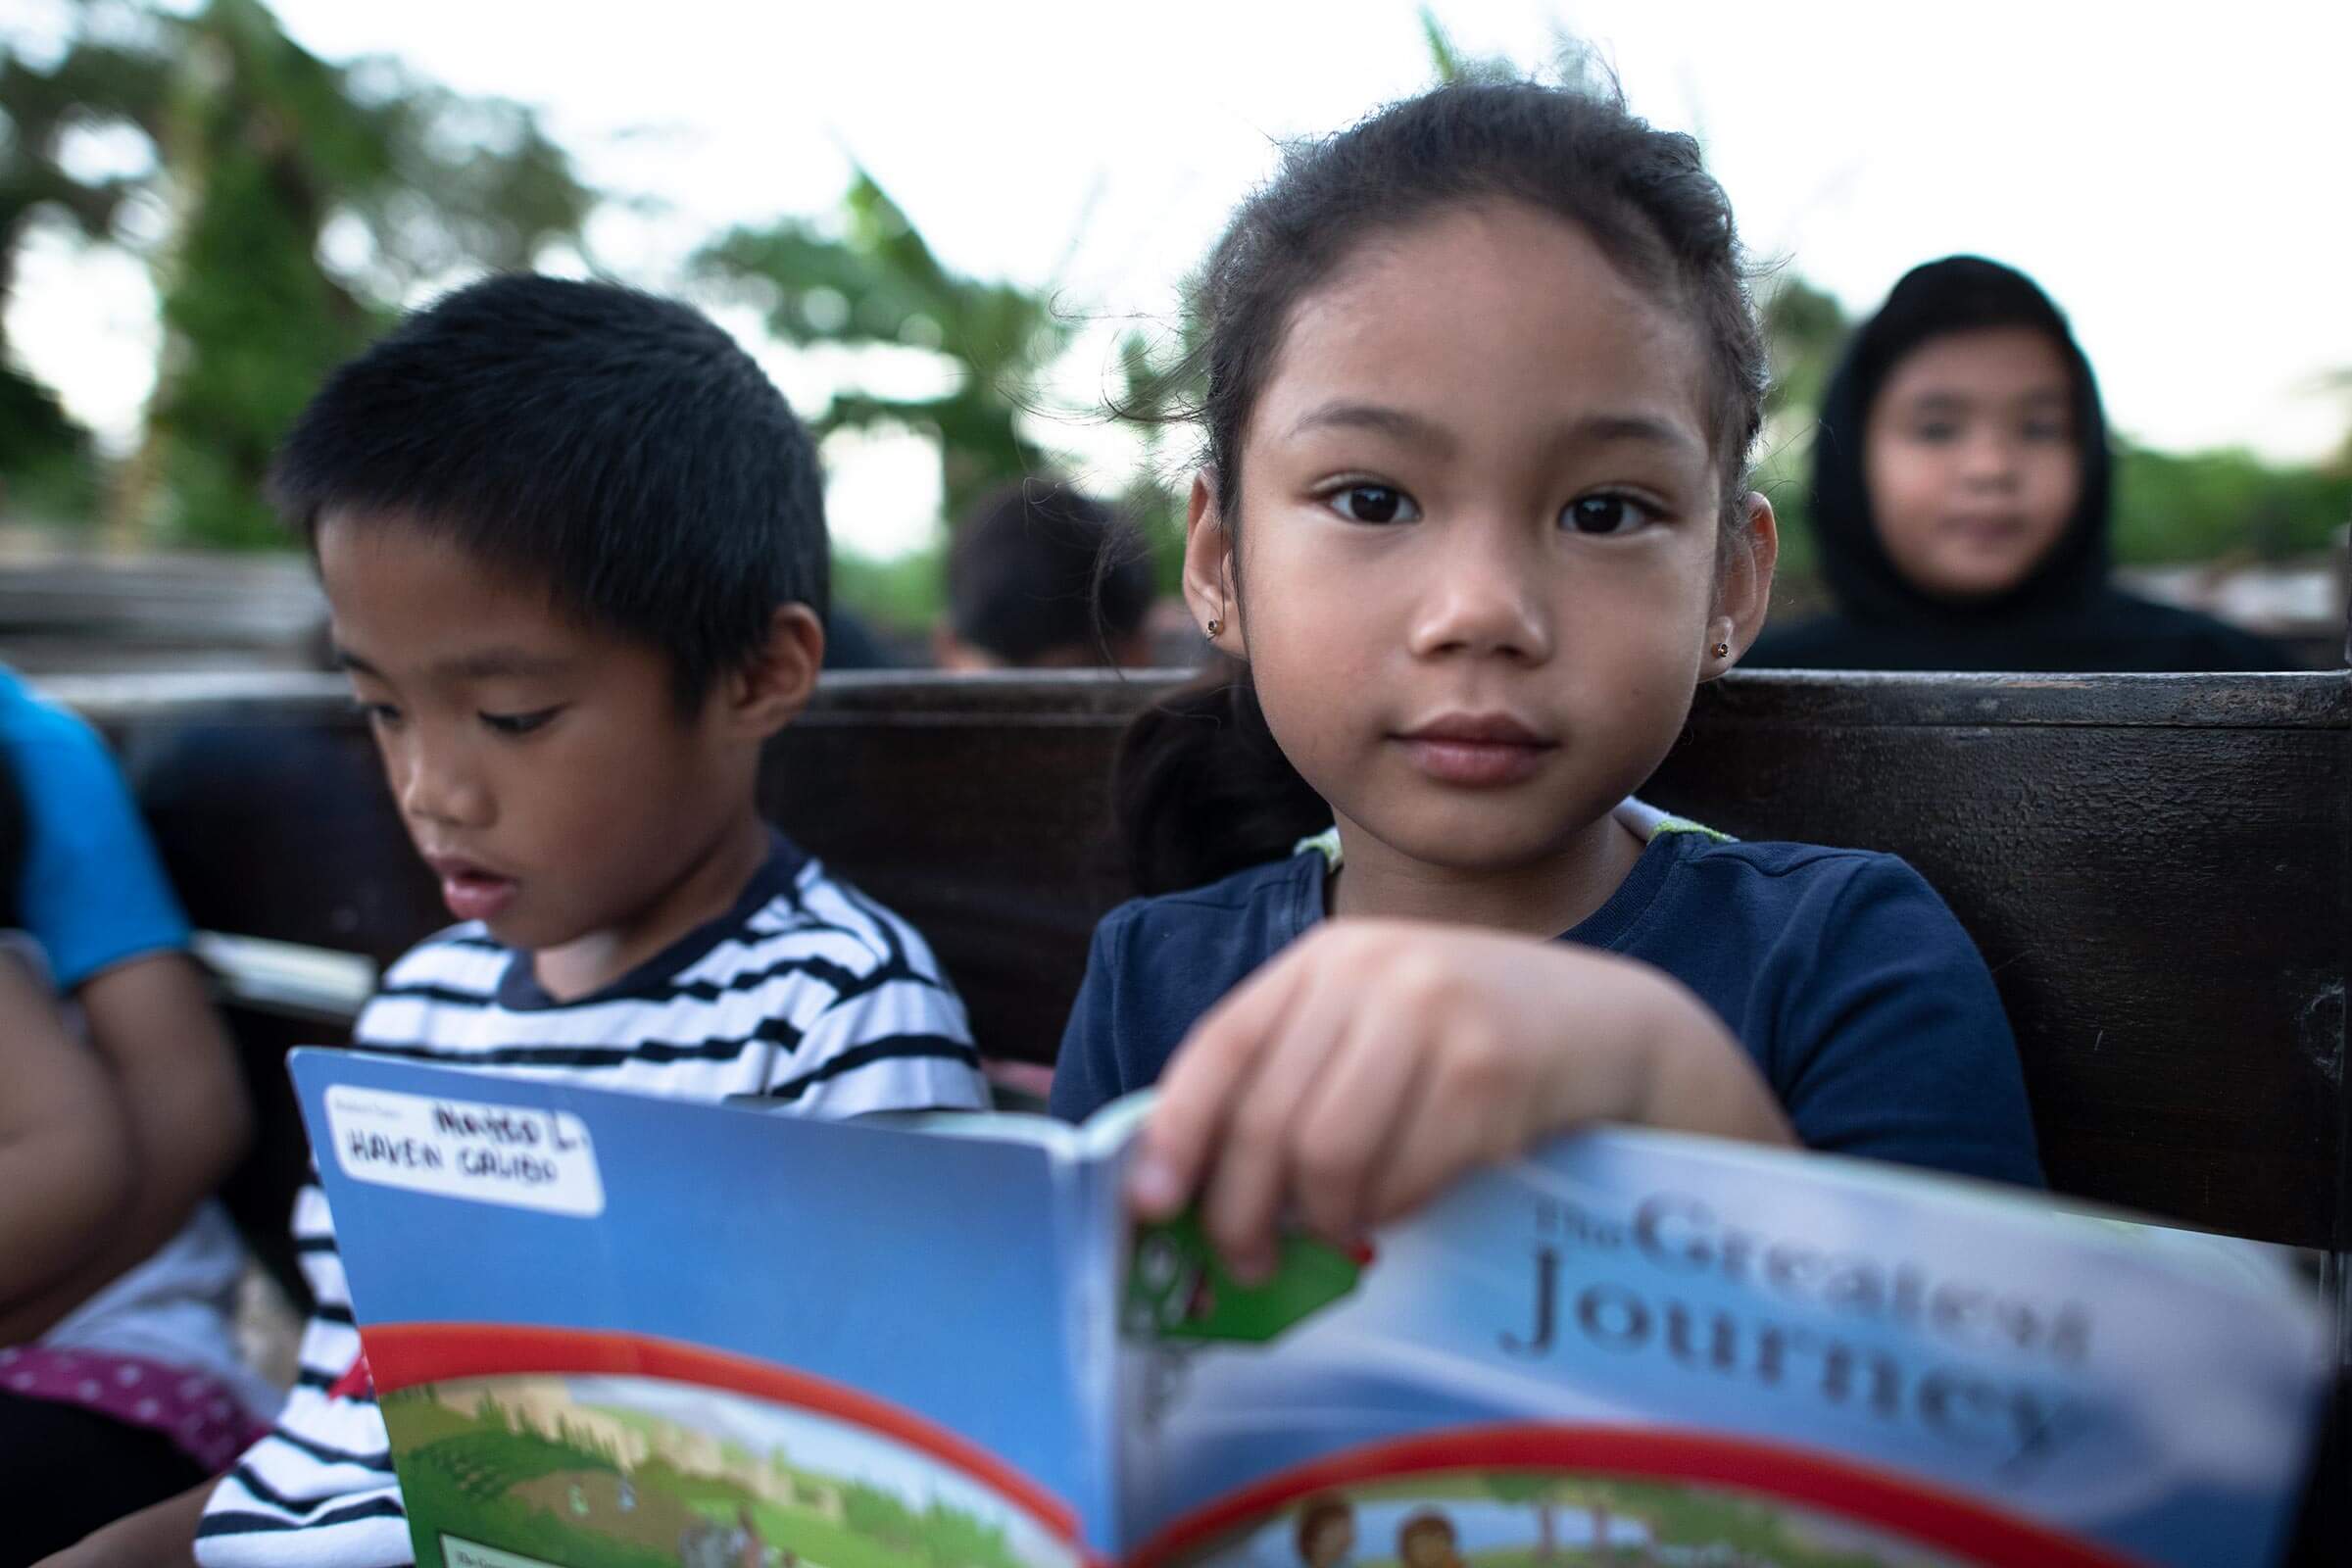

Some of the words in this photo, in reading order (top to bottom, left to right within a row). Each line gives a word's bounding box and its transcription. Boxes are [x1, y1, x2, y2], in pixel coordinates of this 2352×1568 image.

[348, 1127, 444, 1171] HAVEN
[1631, 1188, 2095, 1362] Greatest
[1496, 1245, 2076, 1485] Journey
